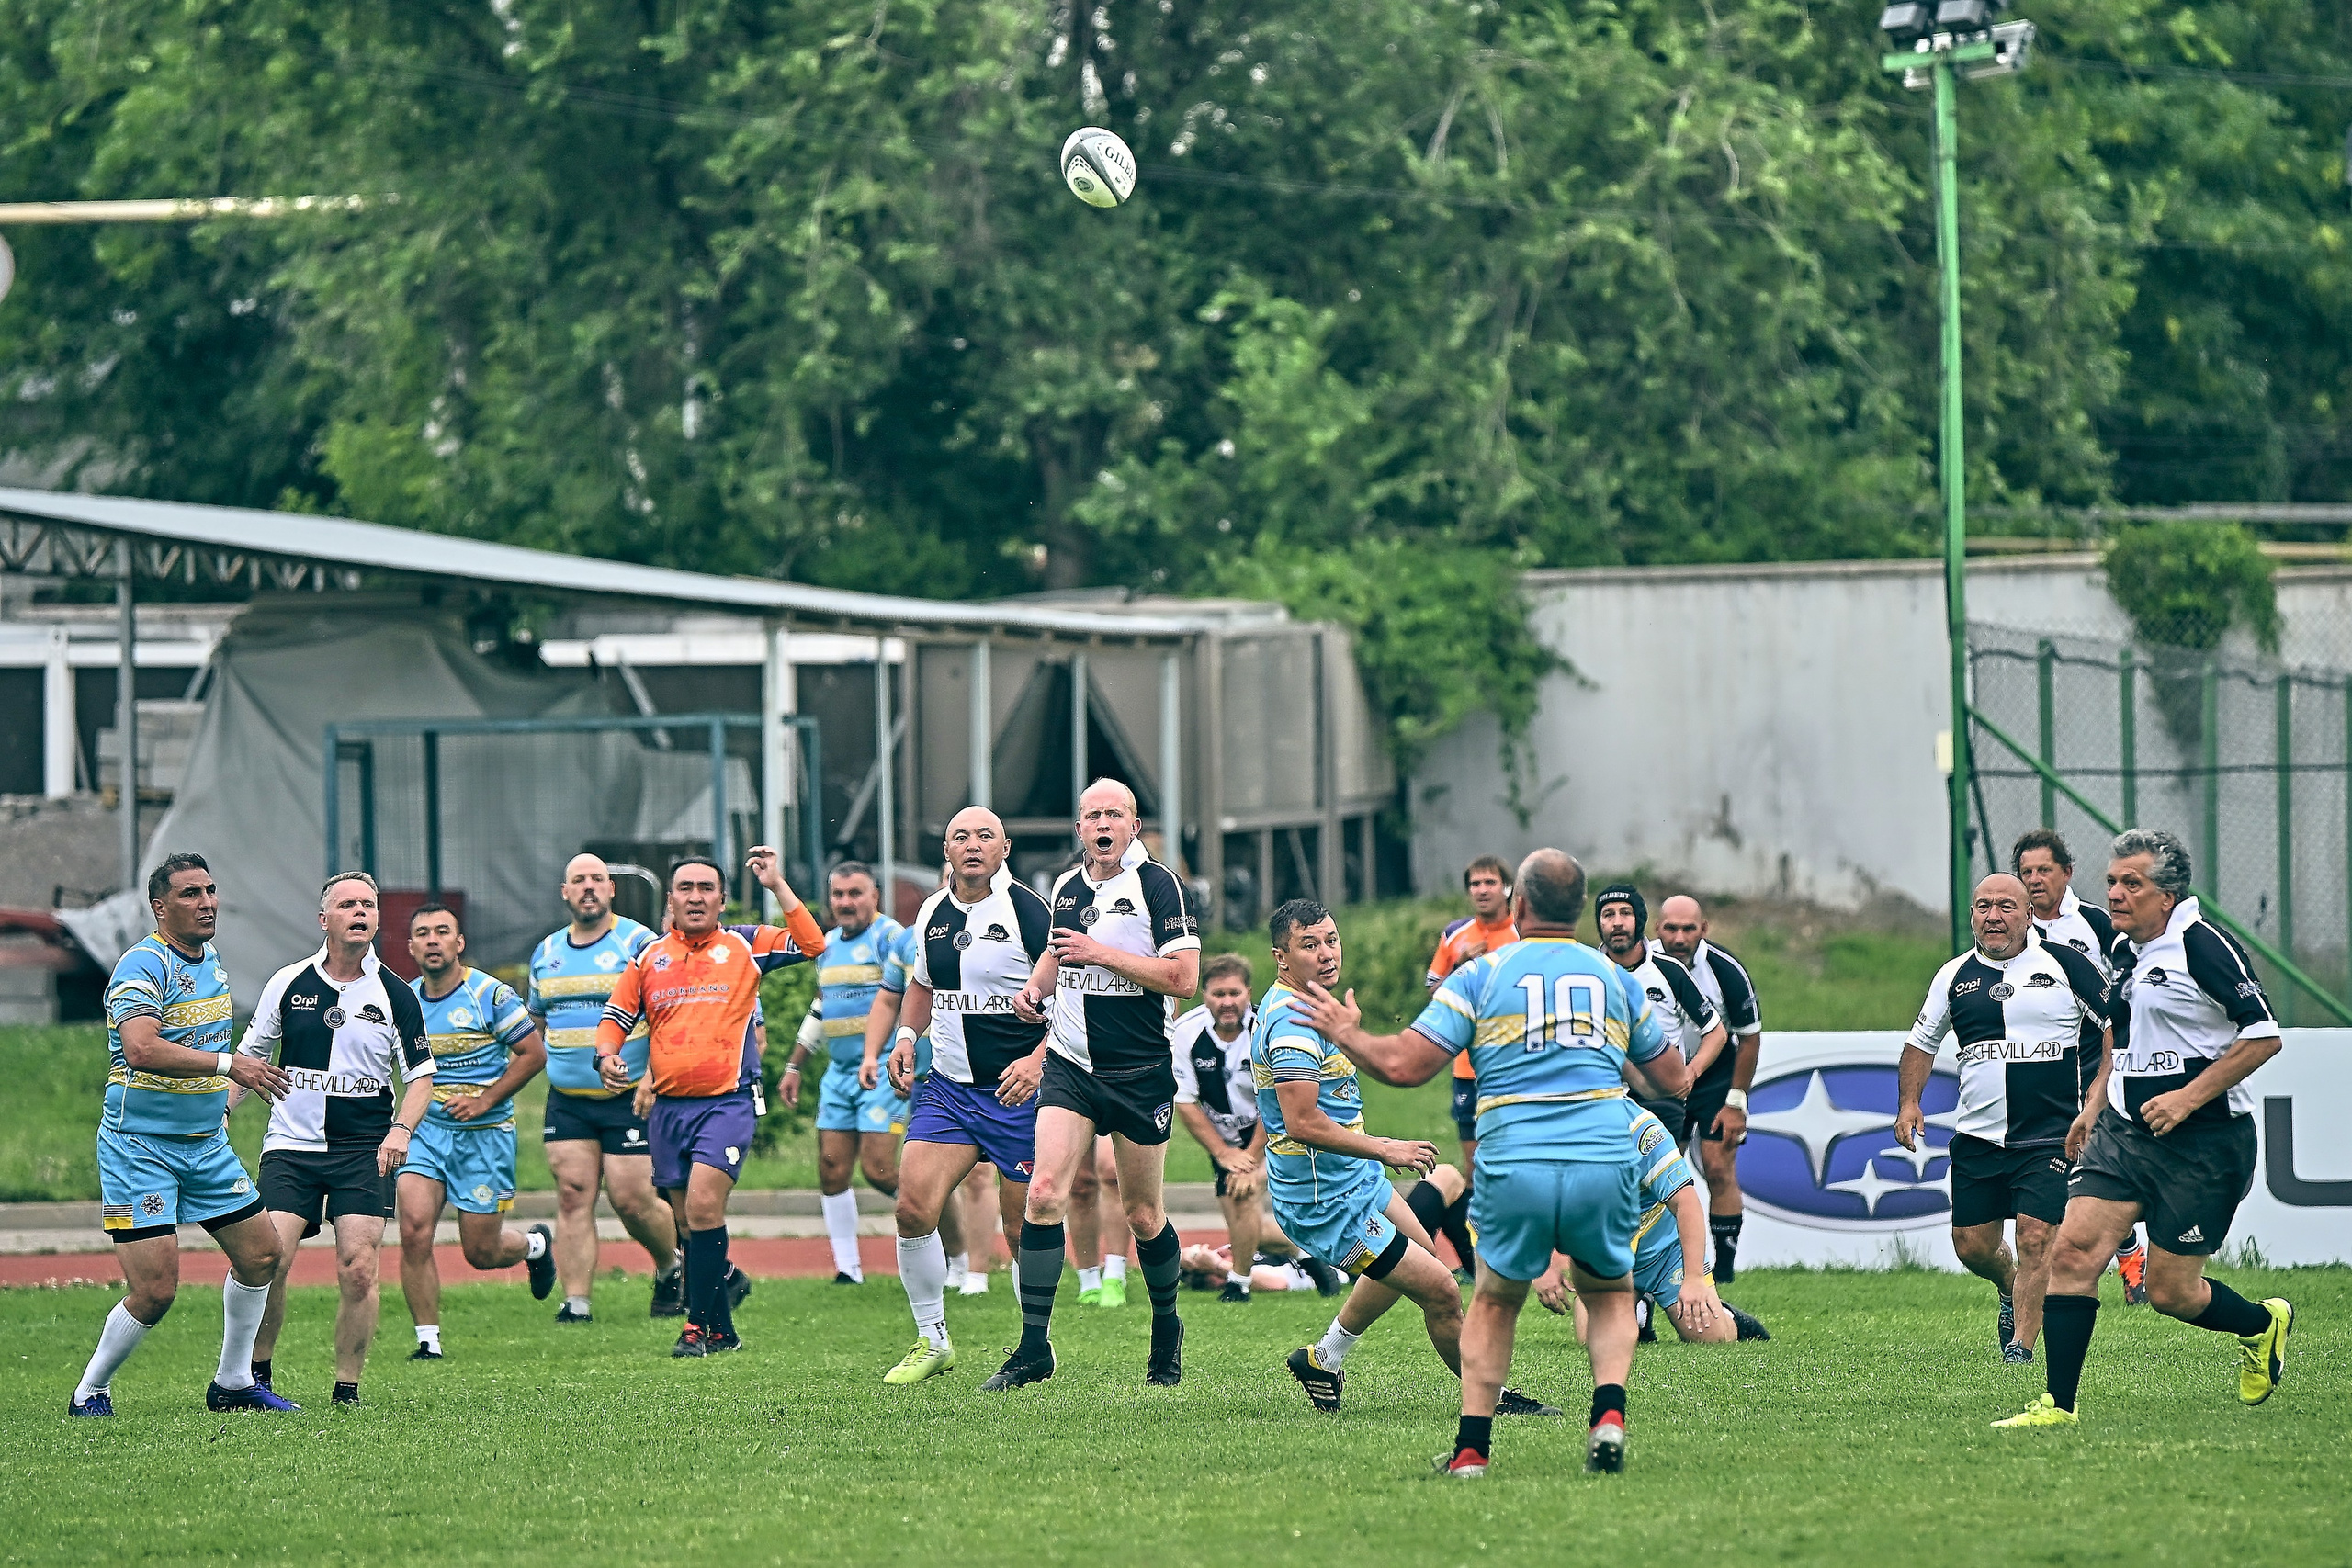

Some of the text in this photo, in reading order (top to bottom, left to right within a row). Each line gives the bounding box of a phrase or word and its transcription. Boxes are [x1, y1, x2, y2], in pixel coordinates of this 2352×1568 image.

[1057, 897, 1077, 907] Orpi
[929, 923, 950, 936] Orpi
[651, 984, 729, 1001] GIORDANO
[1955, 978, 1981, 992] Orpi
[291, 994, 319, 1006] Orpi
[937, 993, 1014, 1011] CHEVILLARD
[1514, 973, 1607, 1053] 10
[1973, 1041, 2061, 1060] CHEVILLARD
[294, 1070, 380, 1093] CHEVILLARD
